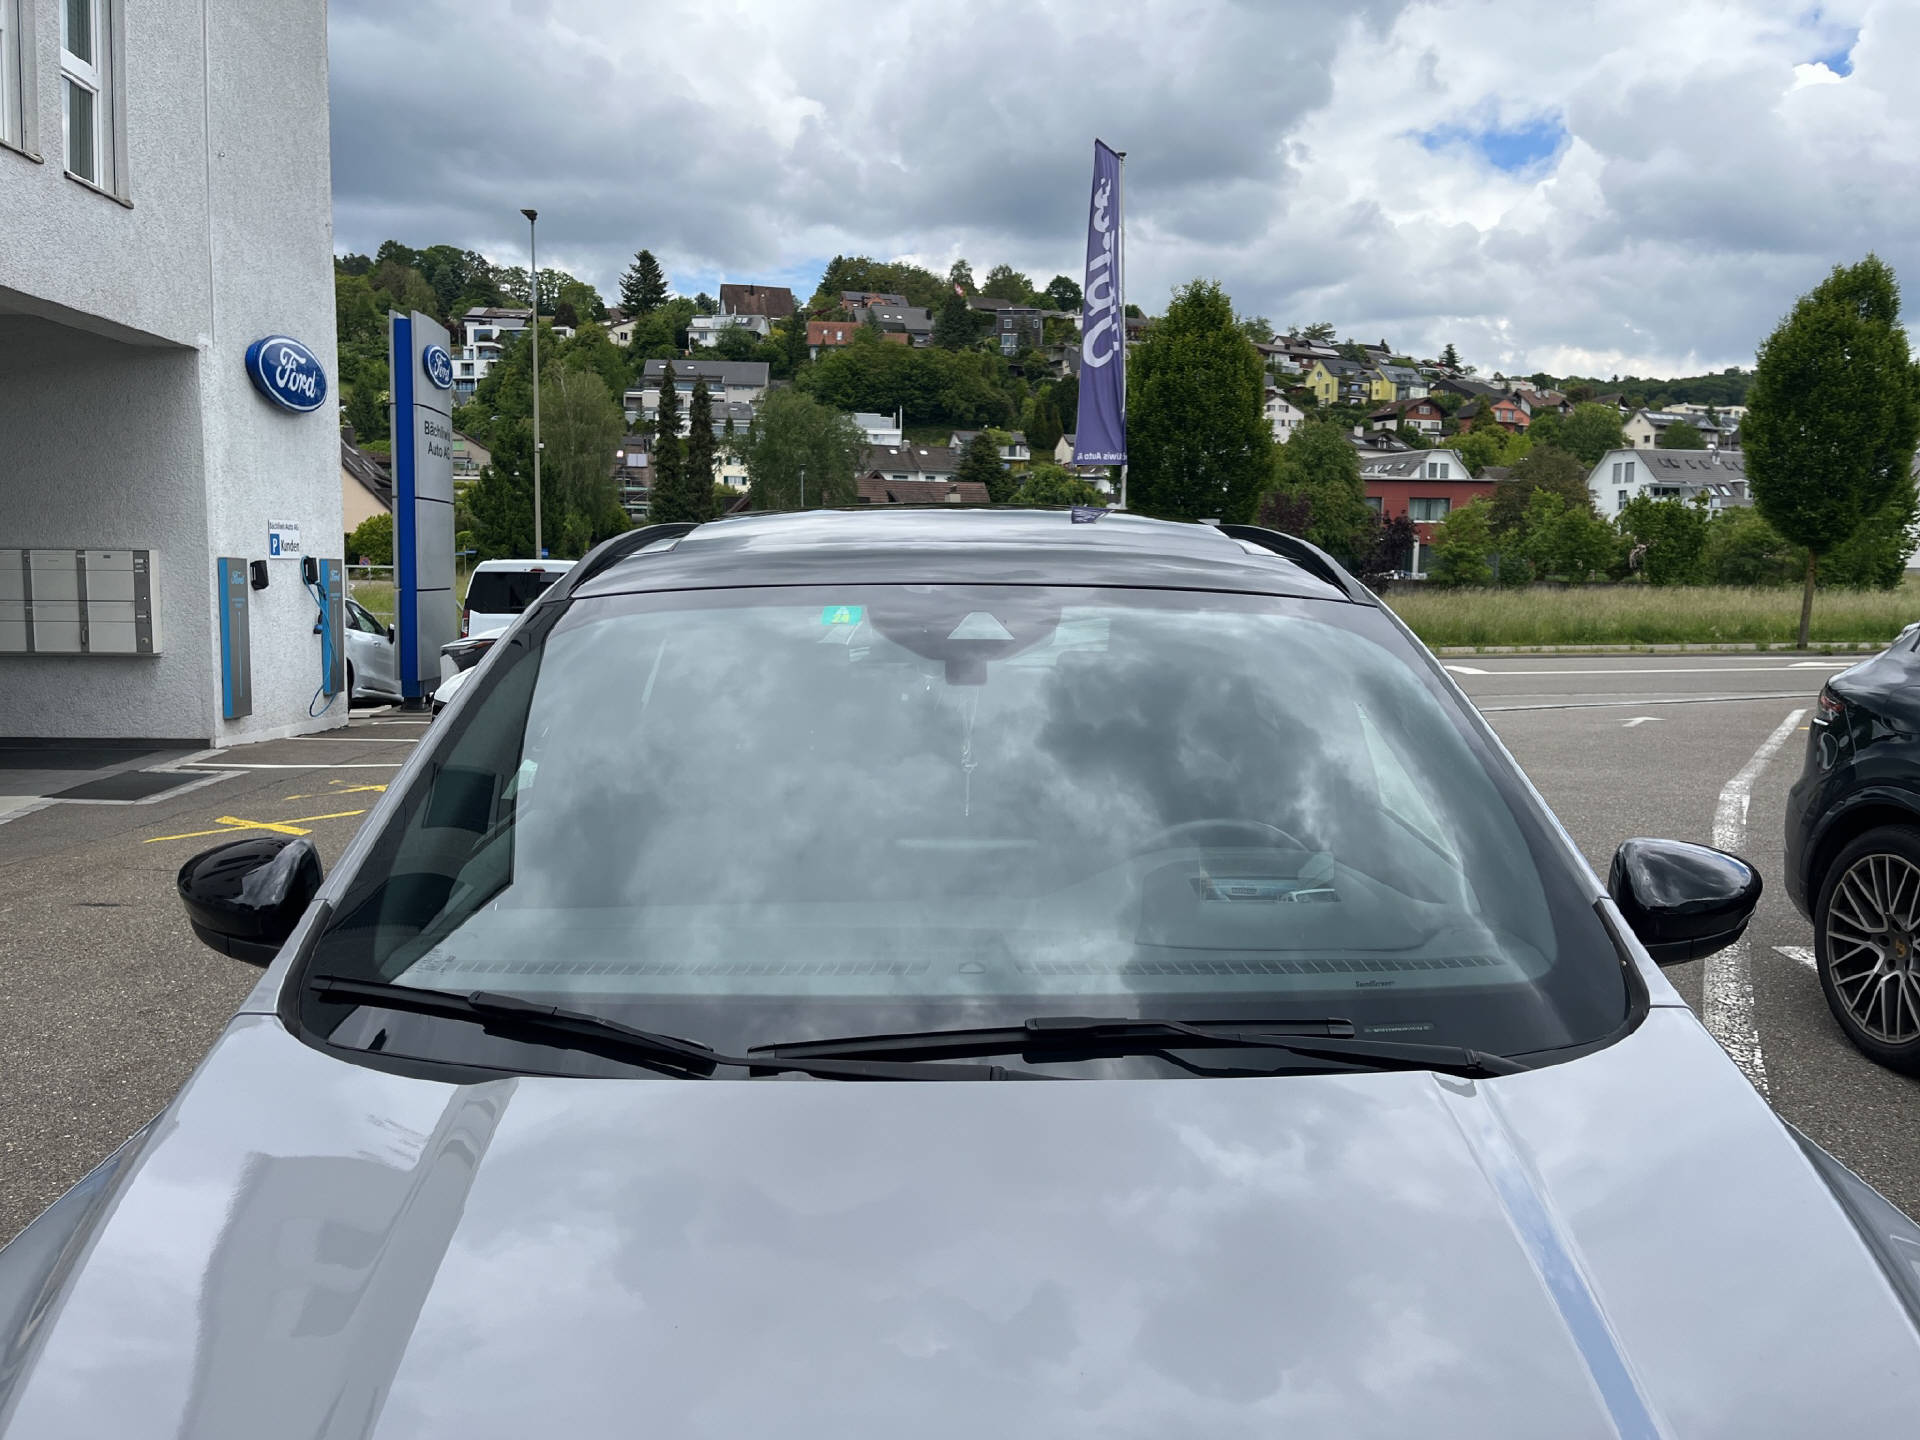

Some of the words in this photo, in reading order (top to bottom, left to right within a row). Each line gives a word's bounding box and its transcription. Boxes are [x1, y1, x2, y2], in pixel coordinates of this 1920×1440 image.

[276, 347, 316, 398] Ford
[434, 352, 450, 381] Ford
[428, 440, 443, 457] Auto
[281, 540, 299, 552] Kunden
